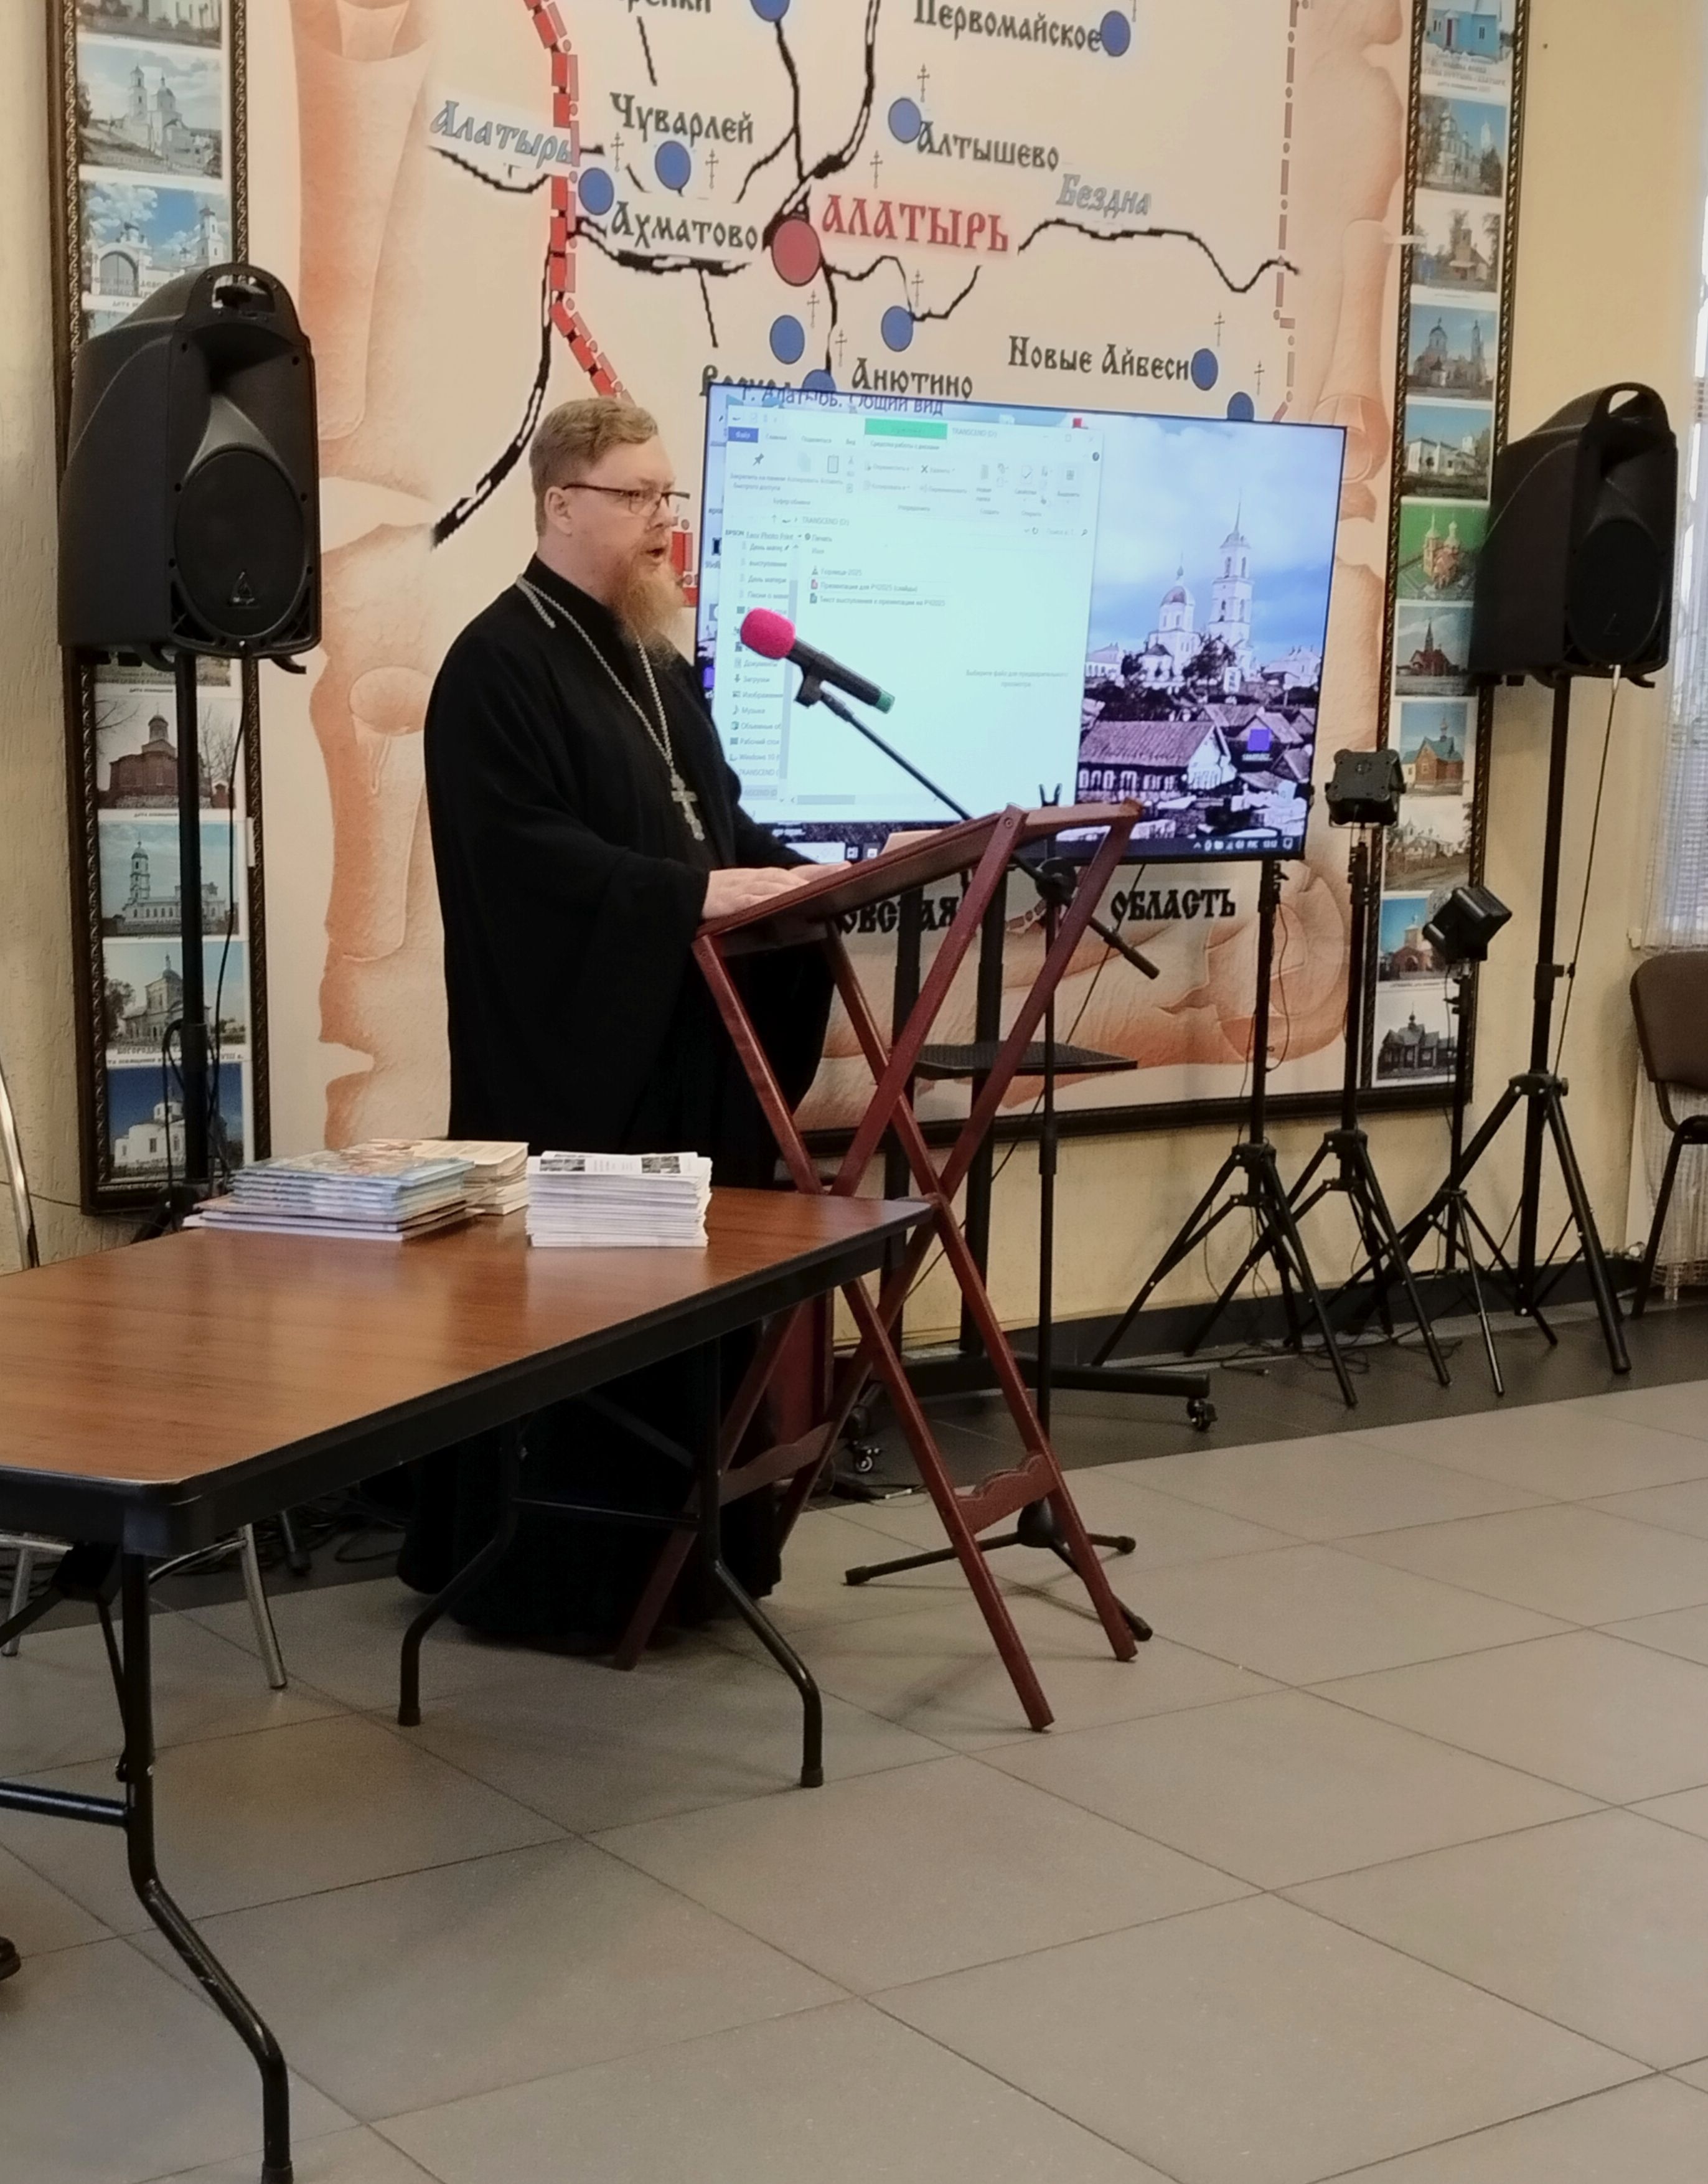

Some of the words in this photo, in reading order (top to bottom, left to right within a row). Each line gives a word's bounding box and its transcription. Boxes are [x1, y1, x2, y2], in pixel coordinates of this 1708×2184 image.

[429, 100, 571, 169] Алатырь
[609, 92, 754, 146] Чуварлей
[917, 121, 1059, 171] Алтышево
[1056, 173, 1152, 217] Бездна
[612, 200, 758, 251] Ахматово
[822, 194, 1008, 252] АЛАТЫРЬ
[851, 357, 974, 399] Анютино
[1008, 336, 1092, 373] Новые
[1102, 343, 1191, 381] Айбеси
[1110, 888, 1236, 921] ОБЛАСТЬ
